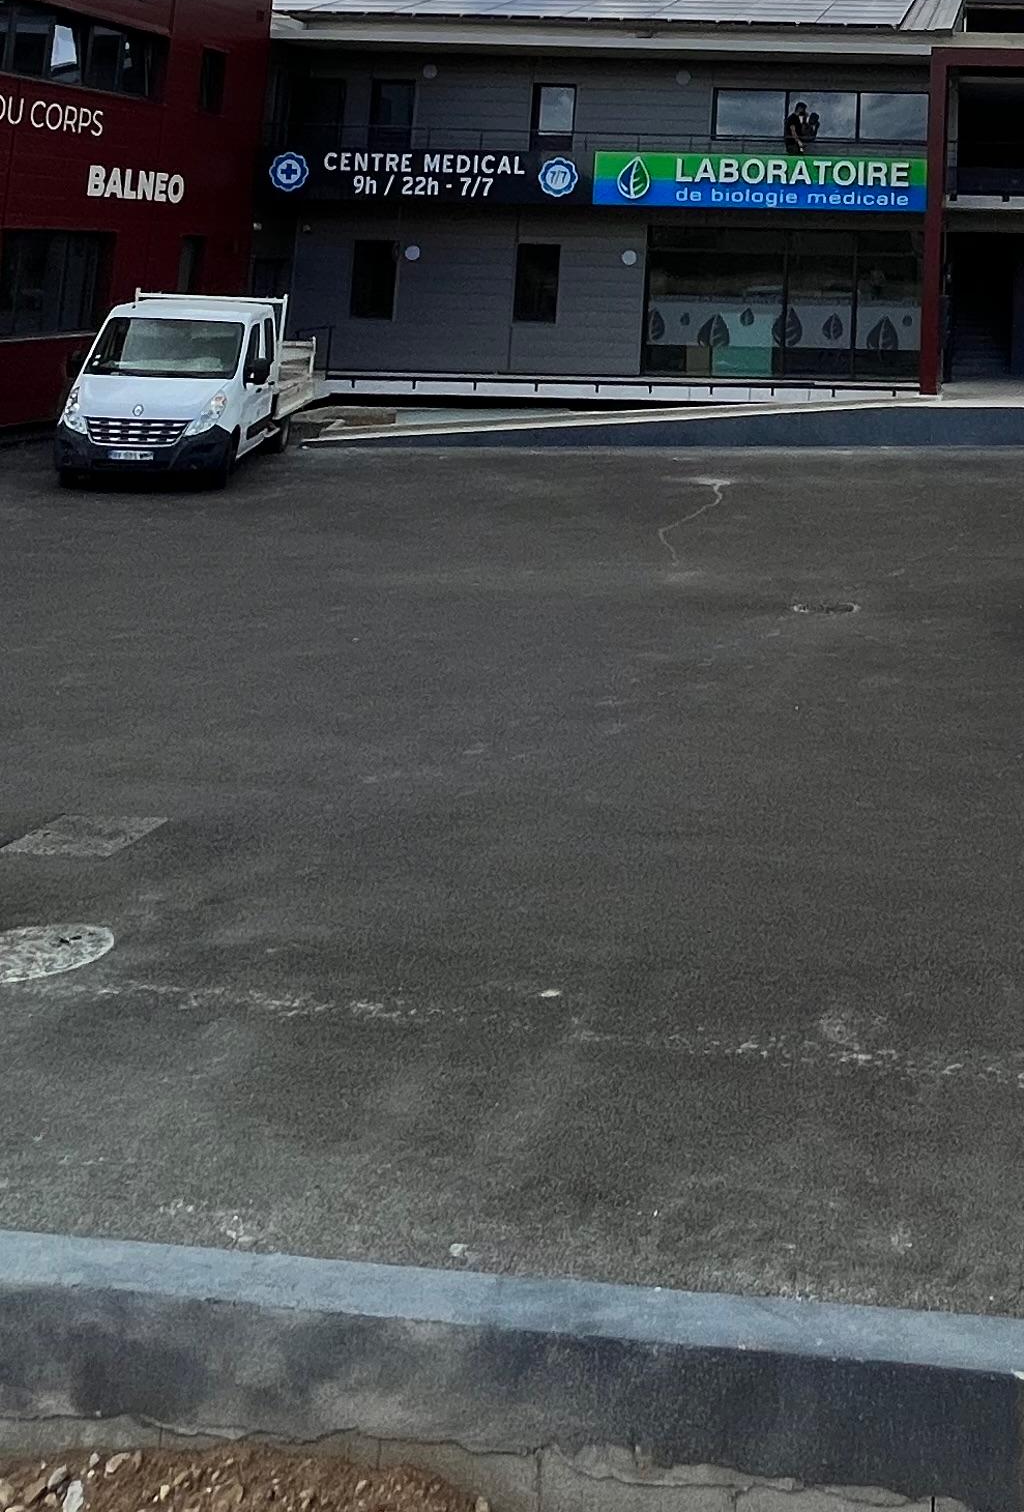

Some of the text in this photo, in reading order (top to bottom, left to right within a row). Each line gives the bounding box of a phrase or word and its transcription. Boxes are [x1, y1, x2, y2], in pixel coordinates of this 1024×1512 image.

[30, 100, 104, 137] CORPS
[323, 152, 526, 175] CENTRE MEDICAL
[675, 158, 910, 188] LABORATOIRE
[87, 164, 185, 204] BALNEO
[353, 176, 377, 195] 9h
[401, 176, 439, 196] 22h
[460, 178, 494, 198] 7/7
[550, 170, 567, 185] 7/7
[675, 187, 909, 207] de biologie médicale
